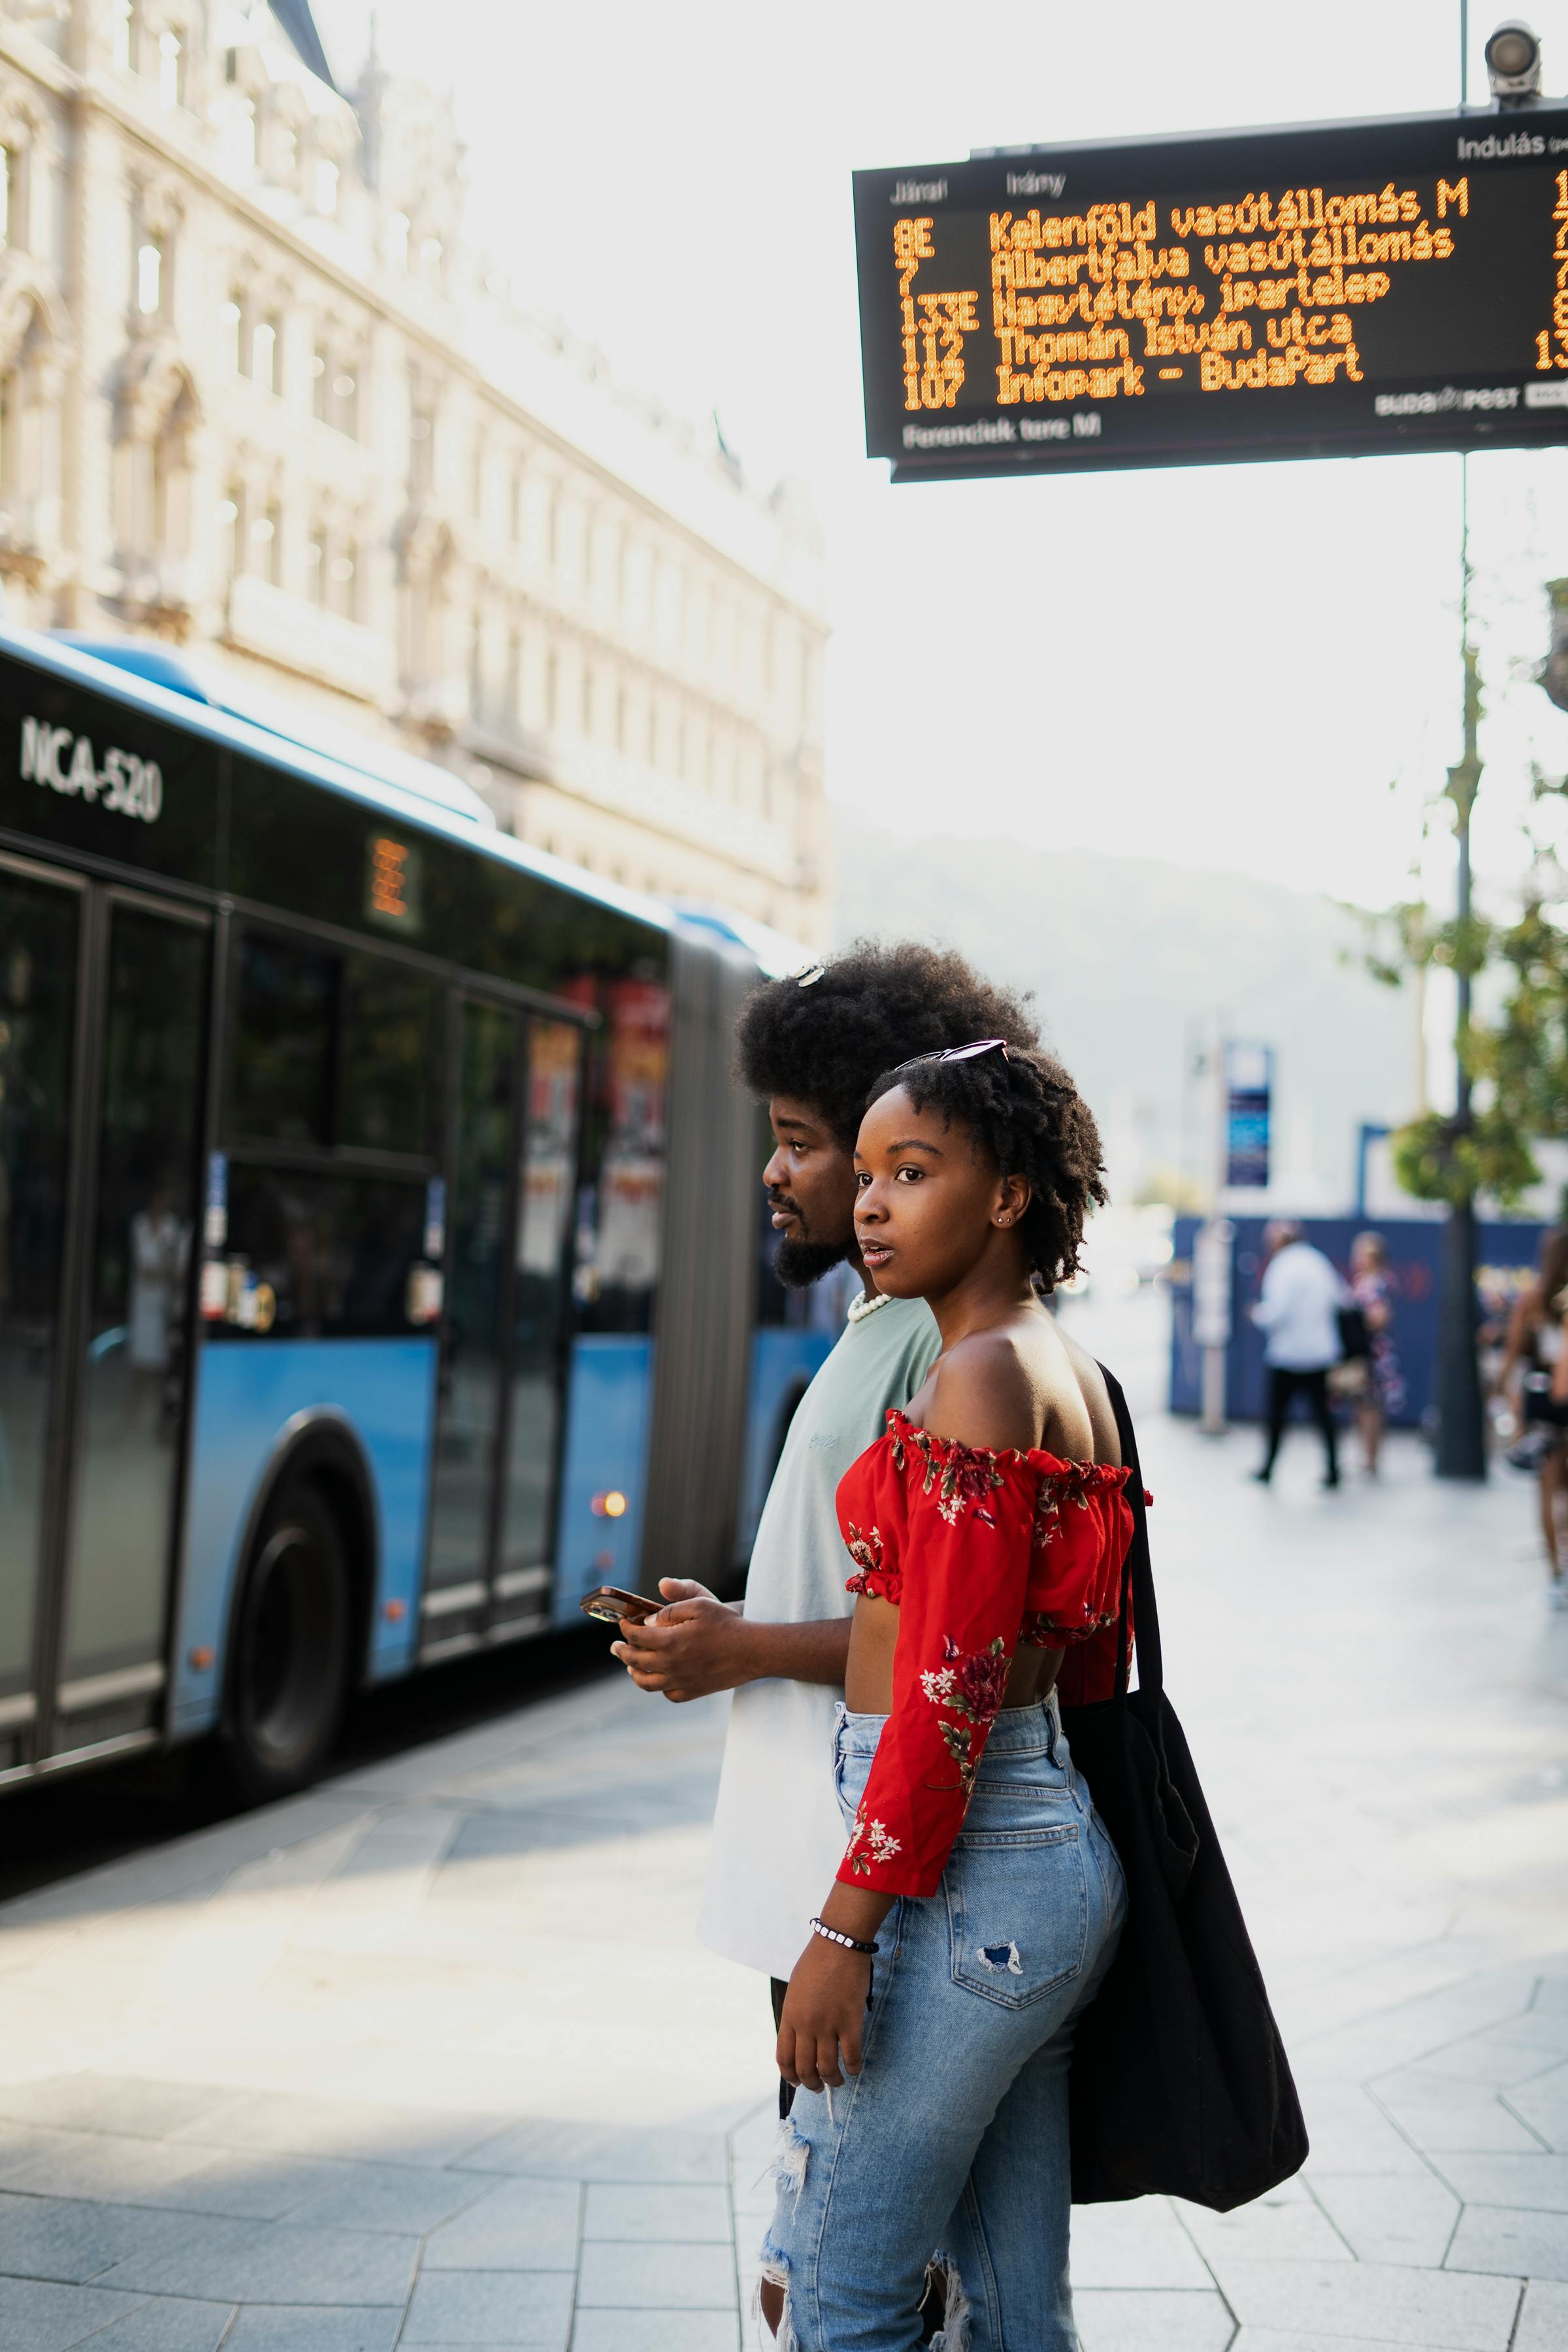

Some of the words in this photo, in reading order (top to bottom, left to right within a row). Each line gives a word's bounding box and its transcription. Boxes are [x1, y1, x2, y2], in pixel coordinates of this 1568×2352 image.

[1007, 169, 1066, 199] Irány
[1457, 132, 1545, 160] Indulás
[894, 217, 935, 258] 8E
[990, 201, 1156, 252] Kelenföld
[1171, 183, 1421, 237] vasútállomás
[1437, 177, 1469, 218] M
[895, 257, 919, 297] 7
[991, 240, 1189, 289] Albertfalva
[1204, 220, 1454, 274] vasútállomás
[901, 291, 979, 335] 133E
[1220, 265, 1390, 312] ipartelep
[902, 331, 964, 373] 112
[994, 320, 1129, 365] Thomán
[1143, 312, 1252, 356] István
[1267, 307, 1353, 348] utca
[904, 368, 965, 410] 107
[996, 356, 1145, 404] Infopark
[1200, 342, 1364, 391] BudaPart
[1073, 411, 1102, 438] M
[20, 715, 163, 824] NCA-520
